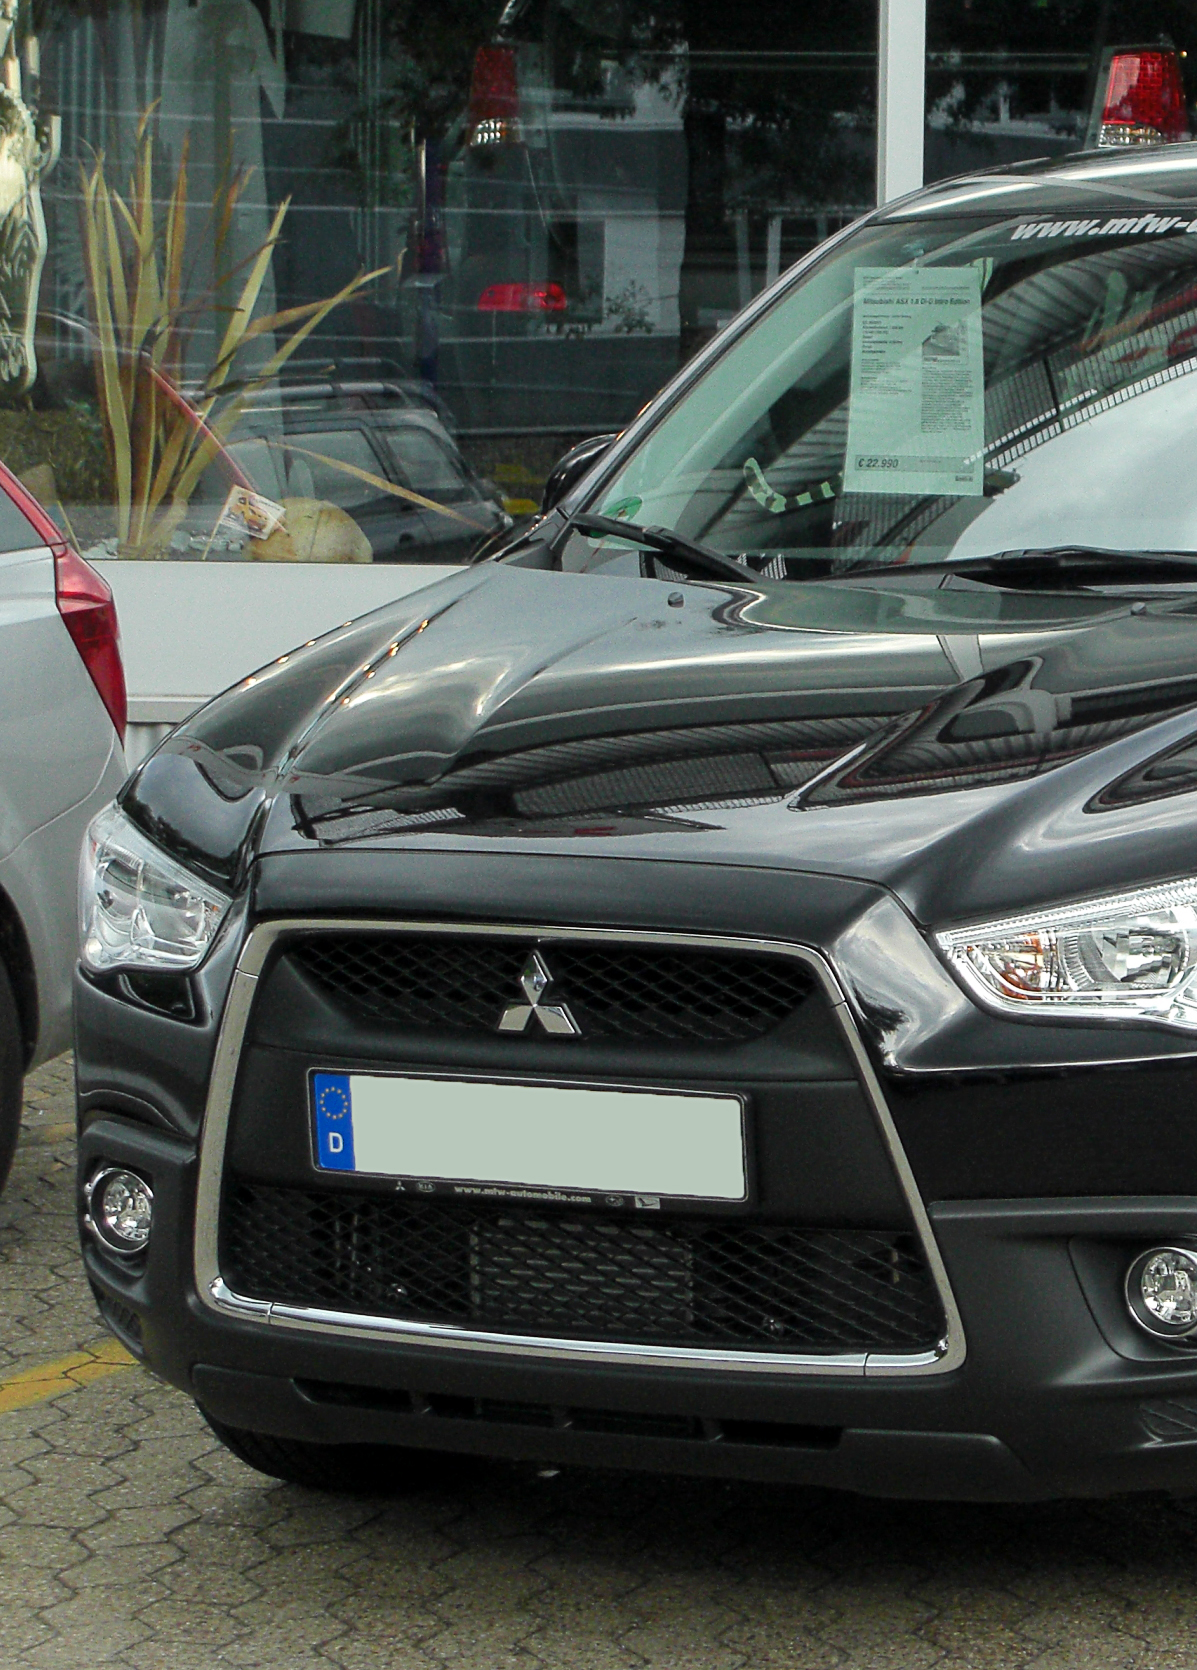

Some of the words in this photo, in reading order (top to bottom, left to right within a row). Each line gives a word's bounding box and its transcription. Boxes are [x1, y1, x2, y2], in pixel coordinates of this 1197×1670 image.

[865, 458, 899, 469] 22.990
[328, 1132, 344, 1153] D
[454, 1184, 592, 1204] www.mtw-automobile.com
